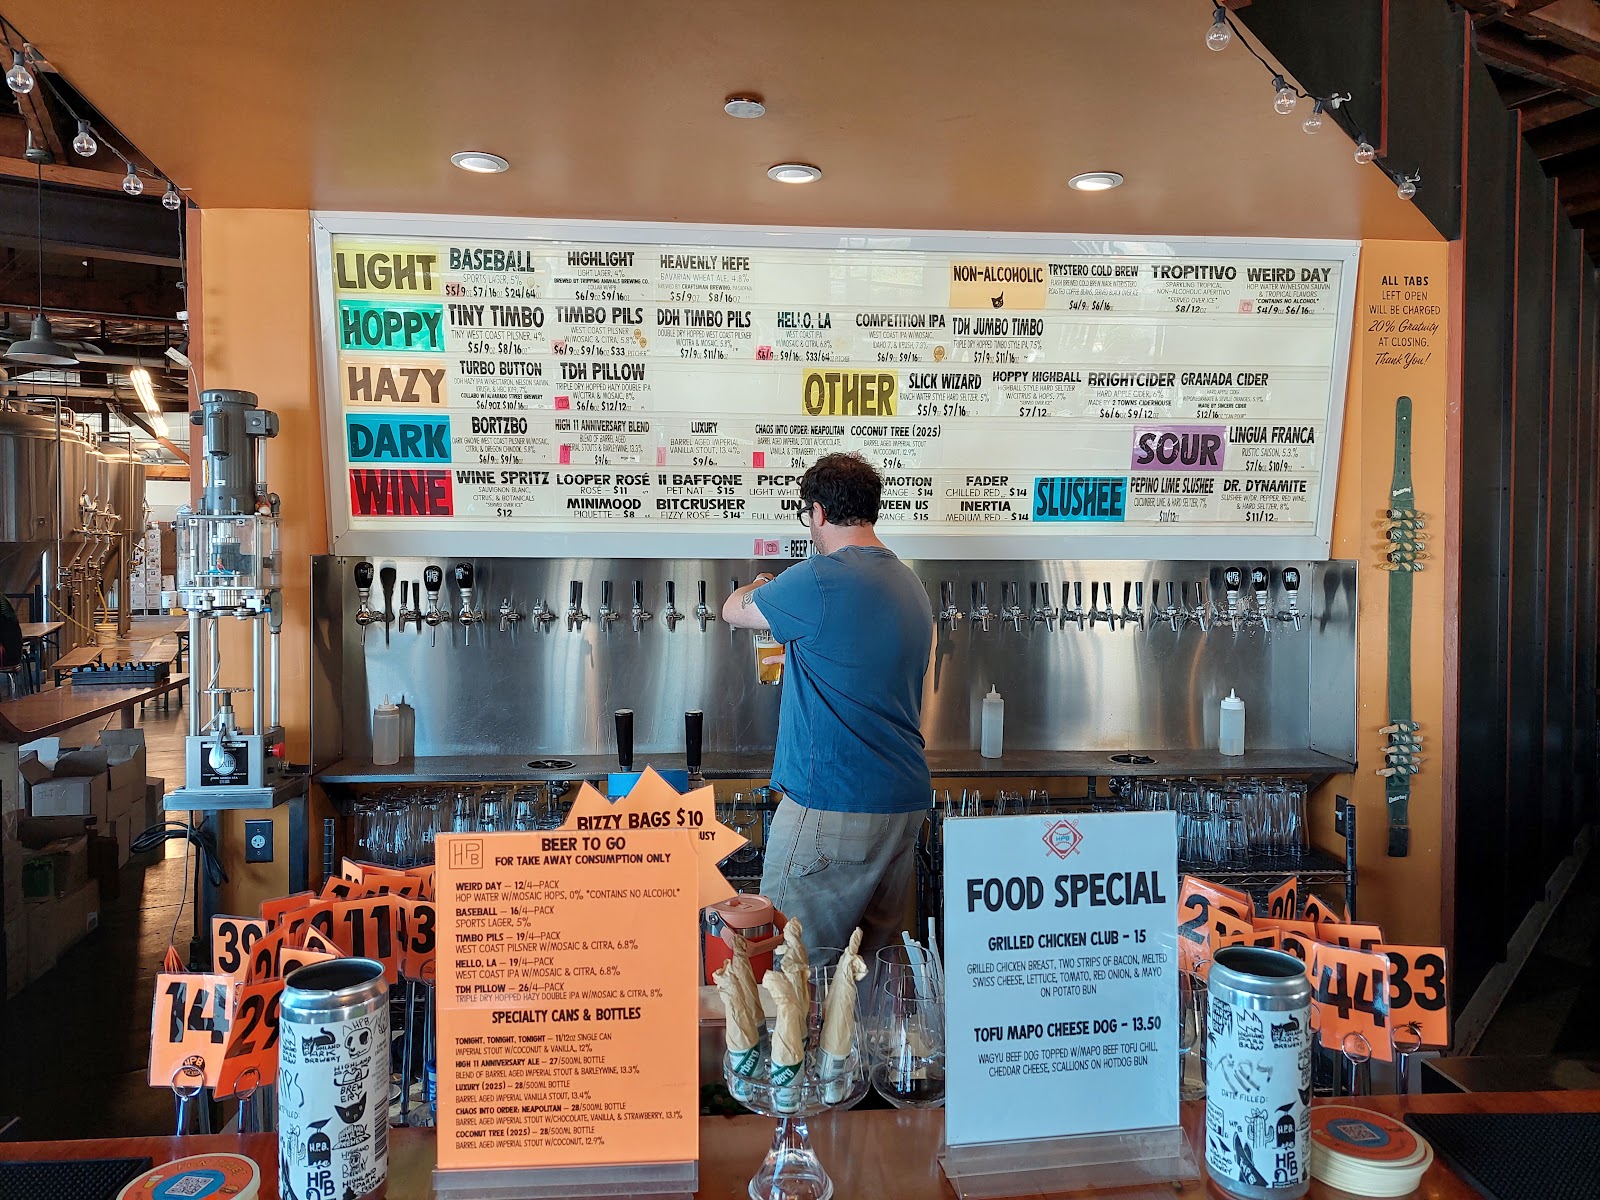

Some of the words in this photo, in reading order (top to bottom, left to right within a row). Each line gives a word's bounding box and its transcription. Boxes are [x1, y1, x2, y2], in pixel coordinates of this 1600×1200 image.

[450, 248, 535, 272] BASEBALL
[568, 252, 634, 267] HIGHLIGHT
[661, 255, 718, 269] HEAVENLY
[722, 257, 749, 270] HEFE
[336, 253, 436, 290] LIGHT
[953, 265, 1043, 283] NON-ALCOHOLIC
[1049, 264, 1088, 276] TRYSTERO
[1091, 265, 1112, 277] COLD
[1115, 266, 1138, 277] BREW
[1152, 265, 1237, 281] TROPITIVO
[1247, 268, 1296, 282] WEIRD
[1301, 268, 1331, 282] DAY
[1382, 276, 1398, 285] ALL
[1404, 276, 1428, 285] TABS
[1382, 291, 1401, 300] LEFT
[1405, 292, 1427, 300] OPEN
[449, 304, 484, 326] TINY
[490, 305, 544, 328] TIMBO
[556, 306, 606, 323] TIMBO
[612, 308, 643, 324] PILS
[1369, 305, 1387, 314] WILL
[1391, 305, 1399, 314] BE
[1403, 306, 1440, 314] CHARGED
[658, 309, 680, 326] DDH
[684, 310, 722, 327] TIMBO
[727, 311, 751, 328] PILS
[818, 314, 831, 329] LA
[856, 313, 925, 328] COMPETITION
[929, 315, 945, 328] IPA
[342, 309, 441, 347] HOPPY
[953, 317, 969, 335] TDH
[973, 318, 1008, 336] JUMBO
[1012, 319, 1044, 336] TIMBO
[1368, 320, 1395, 332] 20%
[1399, 319, 1438, 335] Gratuity
[1378, 337, 1388, 346] AT
[1392, 338, 1429, 347] CLOSING.
[1375, 352, 1402, 365] Thank
[1403, 353, 1431, 369] You!
[460, 361, 495, 375] TURBO
[500, 362, 542, 376] BUTTON
[560, 362, 587, 380] TDH
[592, 363, 645, 381] PILLOW
[909, 373, 937, 389] SLICK
[942, 374, 981, 389] WIZARD
[993, 371, 1029, 382] HOPPY
[1032, 371, 1081, 383] HIGHBALL
[1088, 372, 1176, 387] BRIGHTCIDER
[1181, 373, 1233, 386] GRANADA
[1236, 373, 1268, 386] CIDER
[348, 367, 446, 403] HAZY
[805, 373, 895, 416] OTHER
[472, 417, 527, 434] BORTZBO
[555, 419, 570, 431] HIGH
[581, 420, 626, 432] ANNIVERSARY
[629, 422, 649, 432] BLEND
[691, 422, 718, 433] LUXURY
[756, 425, 774, 434] CHAOS
[775, 425, 787, 434] INTO
[811, 425, 844, 435] NEAPOLITAN
[851, 426, 887, 436] COCONUT
[891, 426, 910, 437] TREE
[912, 425, 941, 438] (2025)
[349, 424, 448, 458] DARK
[1229, 426, 1268, 444] LINGUA
[1271, 427, 1314, 444] FRANCA
[1137, 432, 1221, 465] SOUR
[457, 471, 494, 484] WINE
[501, 472, 550, 485] SPRITZ
[557, 474, 610, 485] LOOPER
[616, 472, 650, 485] ROSÉ
[673, 475, 742, 485] BAFFONE
[966, 476, 1008, 486] FADER
[1131, 477, 1159, 493] PEPINO
[1160, 478, 1181, 493] LIME
[1183, 478, 1214, 494] SLUSHEE
[353, 470, 449, 515] WINE
[1224, 479, 1242, 492] DR.
[1246, 480, 1306, 493] DYNAMITE
[567, 498, 641, 509] MINIMOOD
[656, 499, 746, 510] BITCRUSHER
[1036, 478, 1123, 517] SLUSHEE
[497, 508, 512, 518] $12
[961, 501, 1011, 511] INERTIA
[791, 540, 807, 557] BEER
[577, 816, 621, 829] BIZZY
[629, 812, 670, 828] BAGS
[677, 810, 703, 827] $10
[699, 831, 715, 840] USY
[542, 837, 580, 851] BEER
[584, 838, 602, 850] TO
[608, 837, 625, 850] GO
[454, 843, 480, 865] HPB
[495, 856, 514, 866] FOR
[517, 856, 540, 865] TAKE
[544, 855, 572, 865] AWAY
[575, 854, 643, 865] CONSUMPTION
[647, 853, 671, 863] ONLY
[456, 882, 483, 891] WEIRD
[485, 881, 502, 890] DAY
[967, 876, 1044, 912] FOOD
[1054, 871, 1166, 908] SPECIAL
[456, 908, 497, 916] BASEBALL
[456, 919, 485, 928] SPORTS
[517, 917, 531, 926] 5%
[344, 905, 391, 958] 11
[456, 934, 483, 942] TIMBO
[486, 933, 503, 941] PILS
[989, 937, 1034, 951] GRILLED
[1038, 933, 1086, 948] CHICKEN
[1091, 931, 1118, 945] CLUB
[1135, 929, 1146, 943] 15
[486, 959, 497, 967] LA
[967, 962, 994, 974] GRILLED
[997, 961, 1026, 971] CHICKEN
[1059, 958, 1074, 969] TWO
[1077, 957, 1100, 968] STRIPS
[1103, 956, 1111, 966] OF
[1142, 953, 1167, 964] MELTED
[456, 970, 477, 979] WEST
[479, 969, 505, 978] COAST
[507, 969, 519, 977] IPA
[522, 968, 563, 977] W/MOSAIC
[600, 966, 620, 975] 6.8%
[456, 985, 471, 993] TDH
[474, 984, 506, 993] PILLOW
[1041, 987, 1050, 997] ON
[1053, 986, 1080, 996] POTATO
[1083, 985, 1096, 995] BUN
[1320, 963, 1386, 1027] 44
[165, 982, 229, 1044] 14
[492, 1010, 548, 1023] SPECIALTY
[552, 1009, 579, 1022] CANS
[583, 1010, 591, 1021] &
[597, 1007, 641, 1020] BOTTLES
[352, 1017, 369, 1029] HPB
[974, 1027, 1002, 1042] TOFU
[1007, 1024, 1043, 1040] MAPO
[1047, 1021, 1089, 1037] CHEESE
[1094, 1019, 1117, 1033] DOG
[1133, 1016, 1161, 1031] 13.50
[1276, 1152, 1297, 1176] HPB
